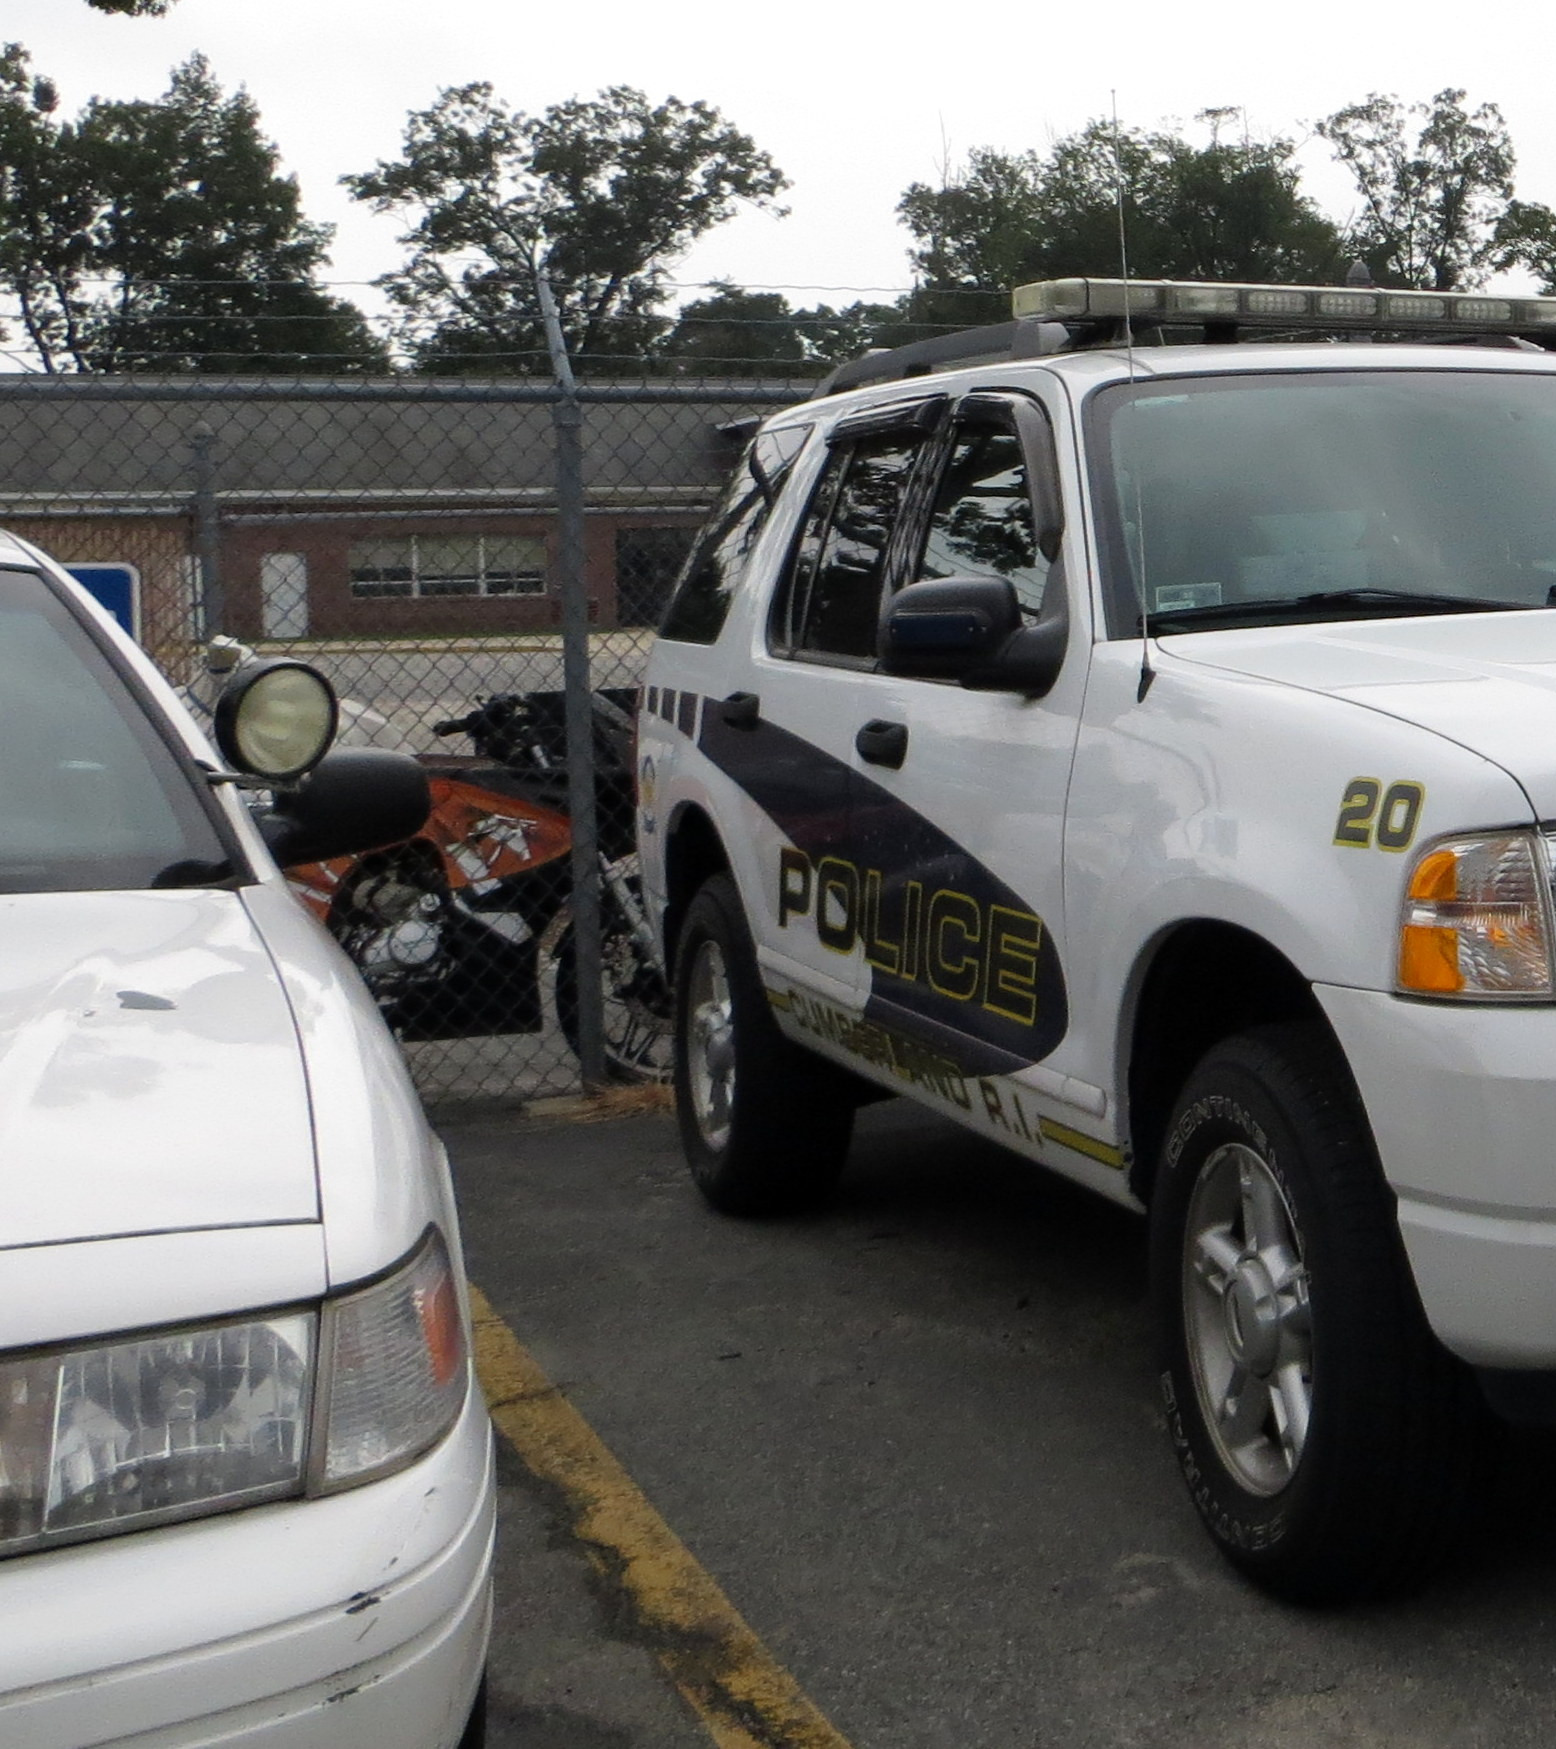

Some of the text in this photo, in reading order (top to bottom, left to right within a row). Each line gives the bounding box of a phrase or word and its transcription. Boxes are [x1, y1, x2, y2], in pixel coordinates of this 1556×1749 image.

[1332, 775, 1428, 854] 20
[776, 845, 1045, 1027] POLICE
[787, 989, 1044, 1147] CUMBERLAND R.I.
